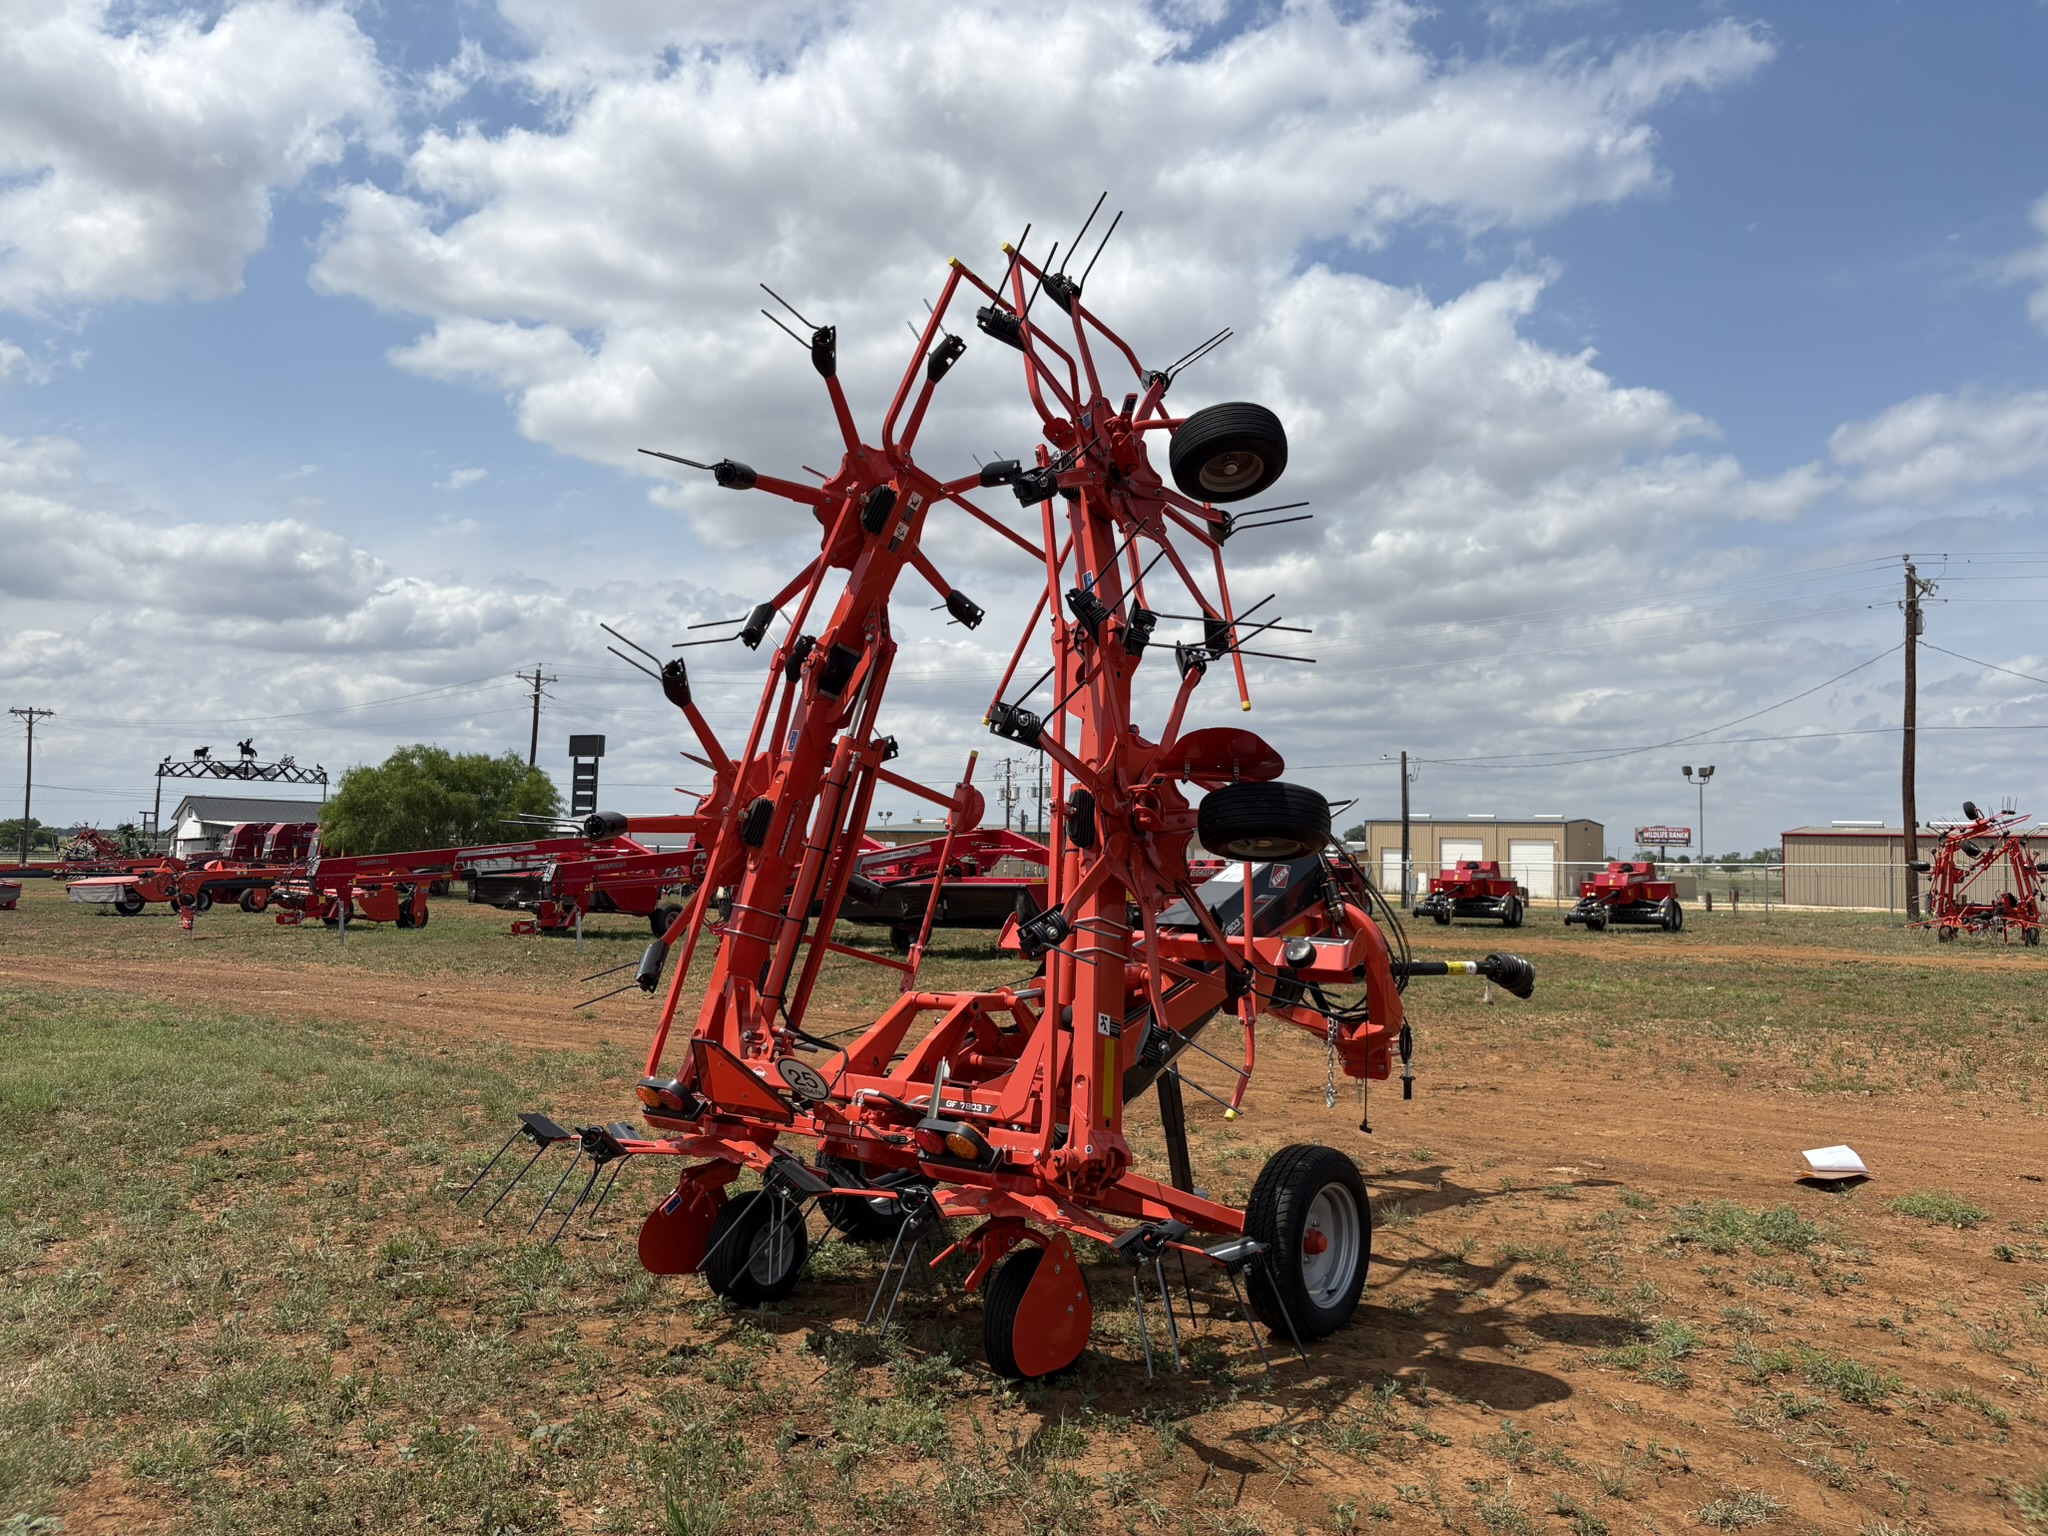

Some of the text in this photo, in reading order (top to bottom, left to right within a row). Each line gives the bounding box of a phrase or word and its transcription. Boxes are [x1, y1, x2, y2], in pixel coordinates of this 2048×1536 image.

[1643, 831, 1689, 839] WILDLIFE RANCH
[1271, 866, 1290, 887] KUHN
[787, 1069, 819, 1088] 25
[945, 1099, 992, 1113] GF 7803 T
